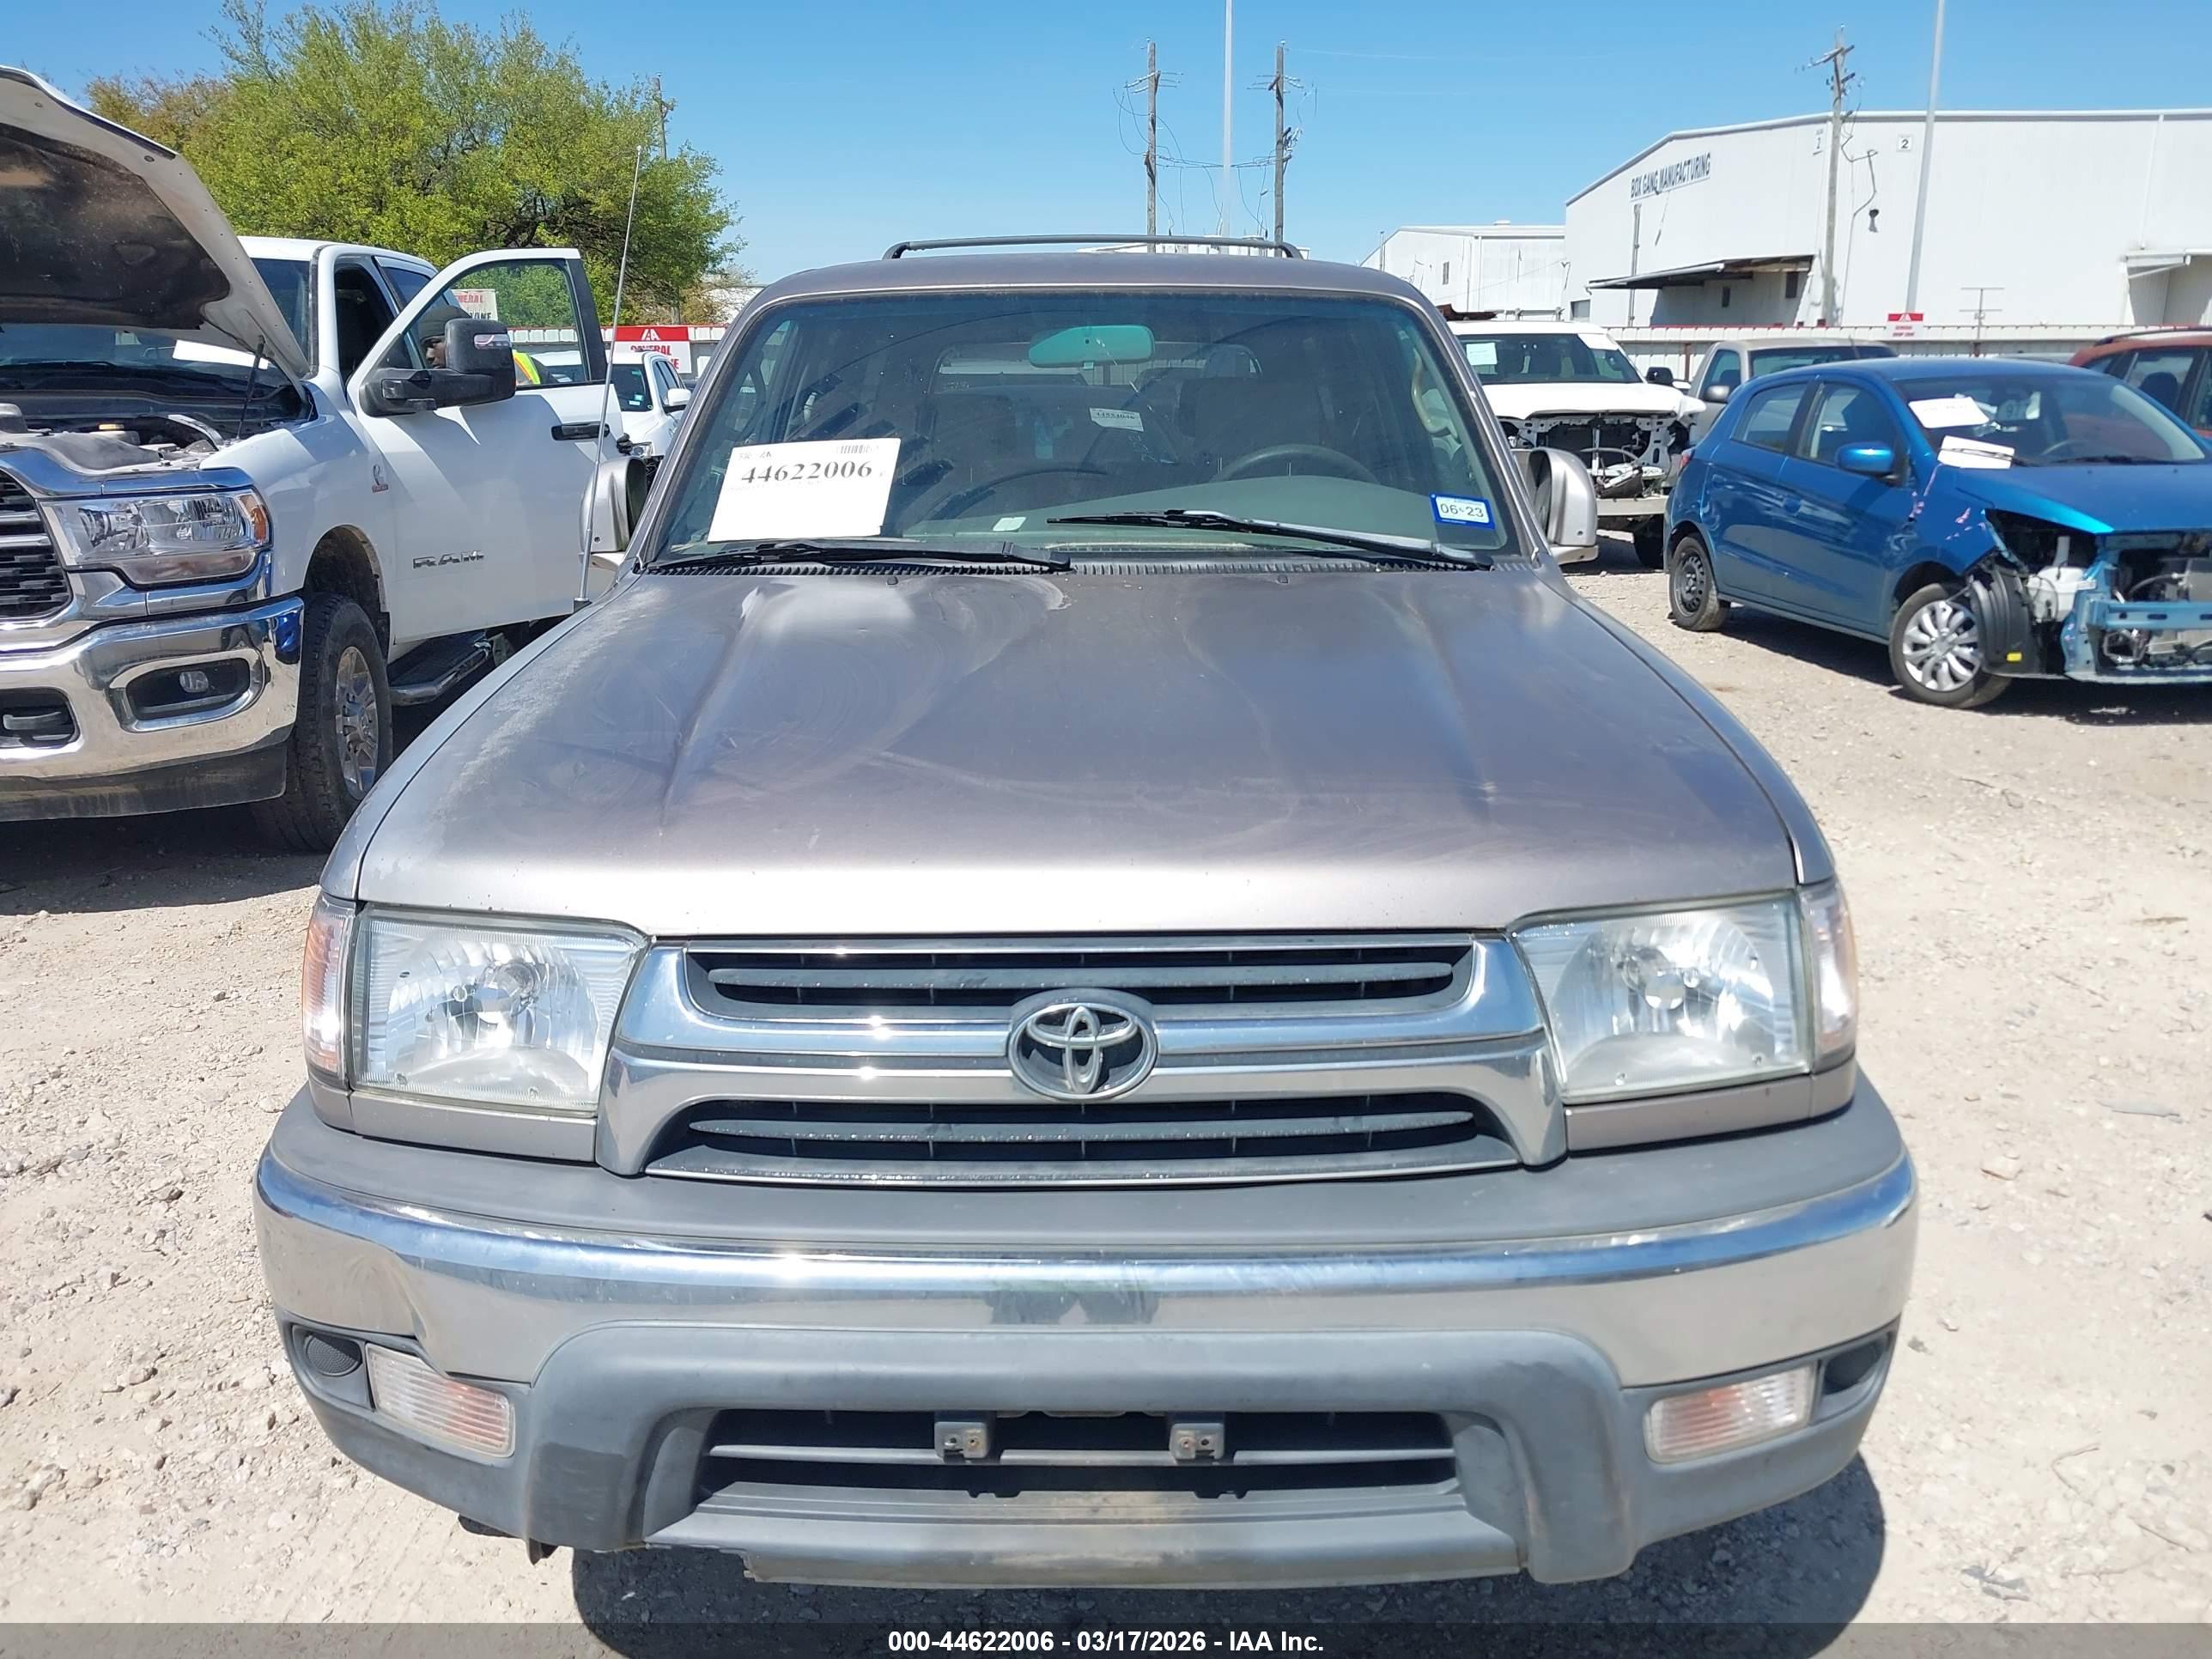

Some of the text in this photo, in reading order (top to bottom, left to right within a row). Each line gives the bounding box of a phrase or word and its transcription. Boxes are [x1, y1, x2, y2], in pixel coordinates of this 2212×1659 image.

[1901, 139, 1909, 149] 2
[1631, 175, 1643, 198] BOX
[1659, 152, 1711, 191] MANUFACTURING
[741, 460, 872, 483] 44622006
[413, 550, 484, 568] RAM
